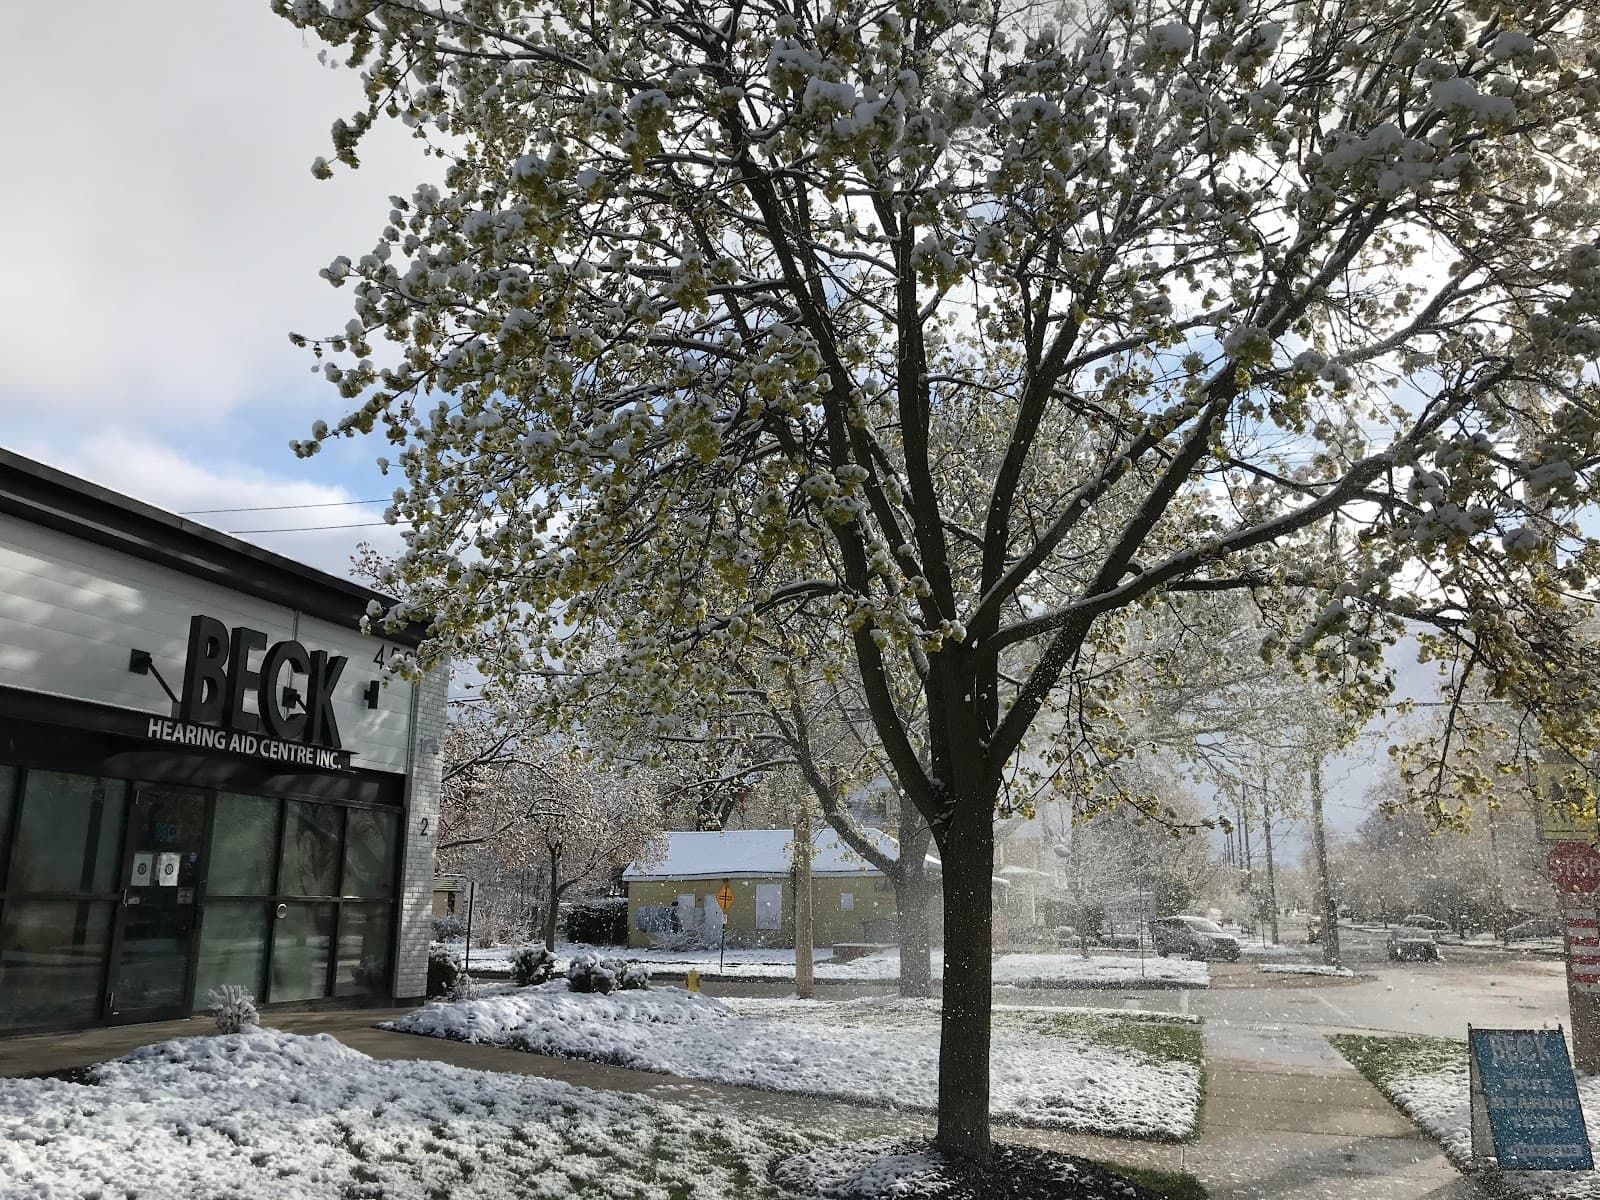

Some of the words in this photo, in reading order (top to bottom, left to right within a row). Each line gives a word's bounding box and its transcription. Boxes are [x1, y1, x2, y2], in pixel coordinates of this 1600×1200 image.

[181, 615, 348, 749] BECK
[148, 718, 226, 750] HEARING
[229, 733, 257, 754] AID
[260, 739, 313, 766] CENTRE
[316, 750, 342, 769] INC.
[420, 817, 429, 836] 2
